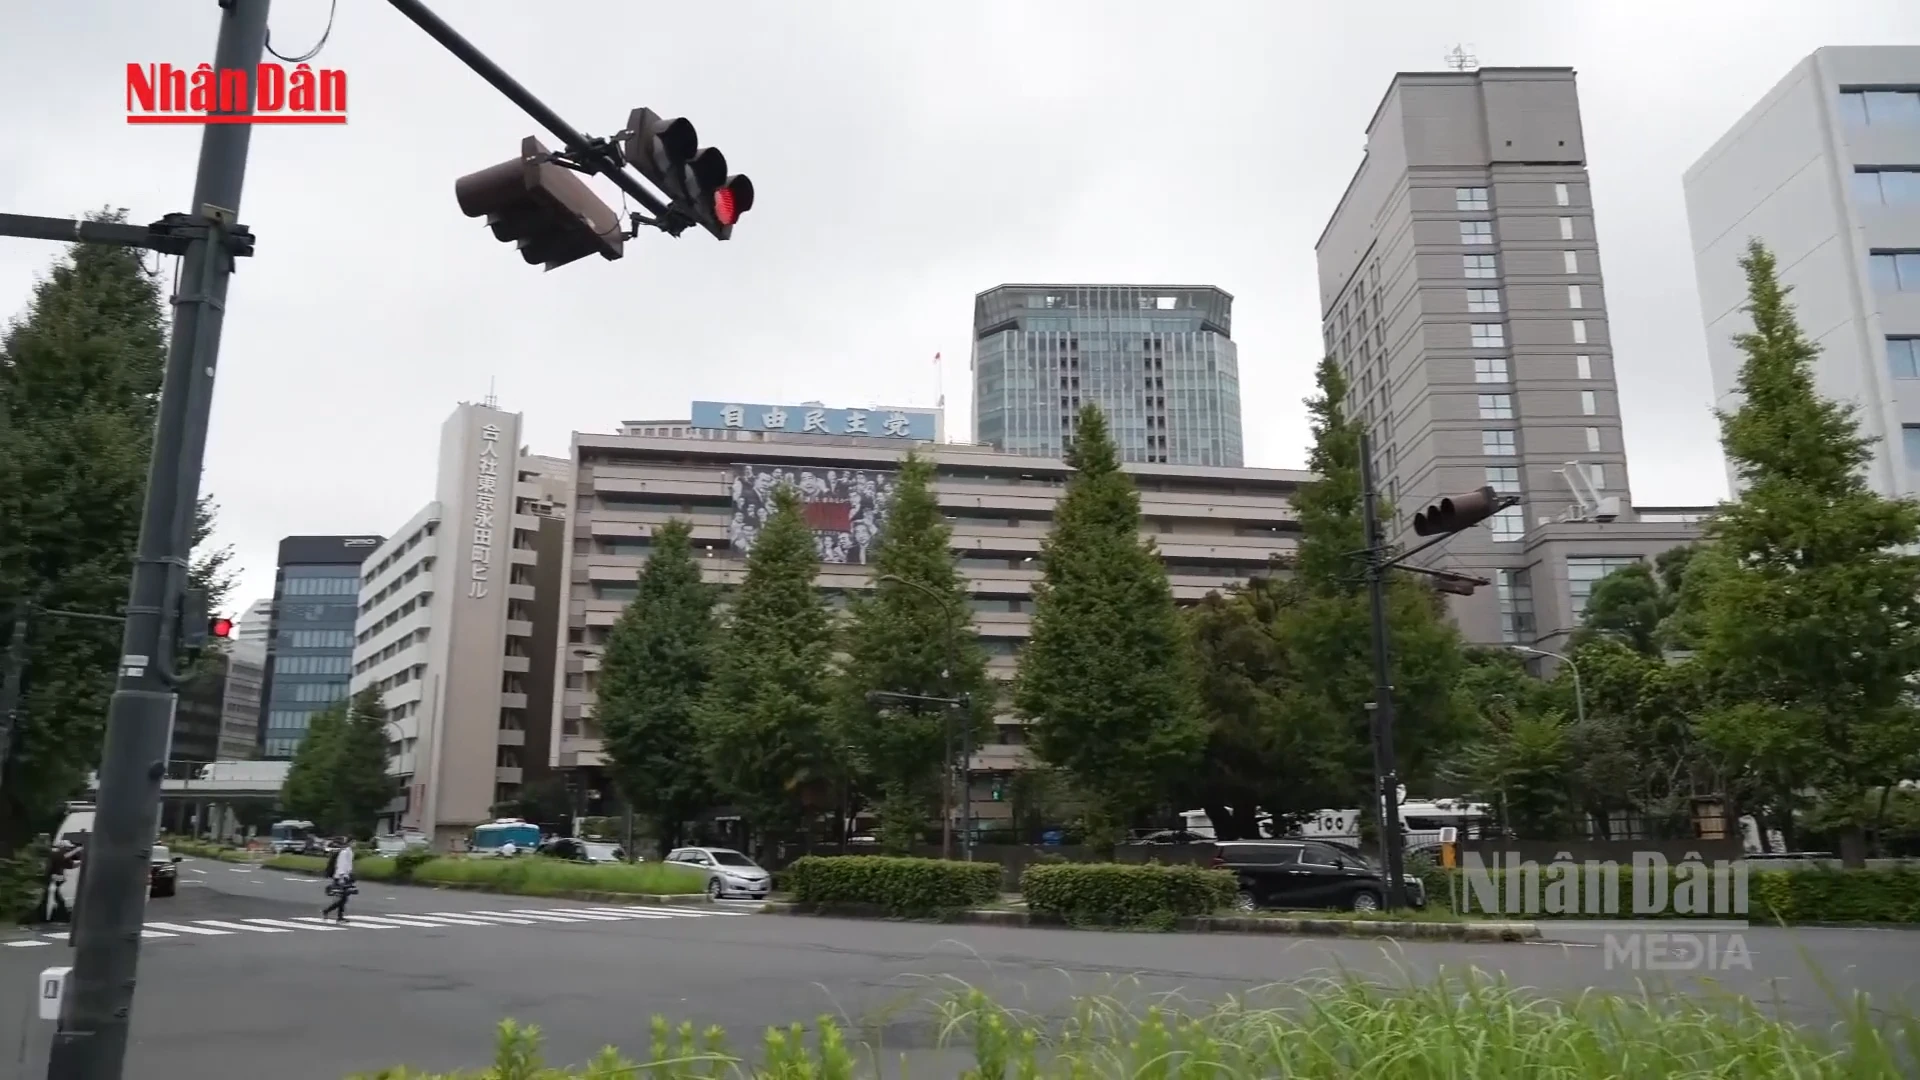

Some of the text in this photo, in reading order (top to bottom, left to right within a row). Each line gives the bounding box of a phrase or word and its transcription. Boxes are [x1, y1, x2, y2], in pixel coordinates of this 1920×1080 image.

[719, 404, 910, 437] 自由民主党
[467, 422, 500, 600] 合人社東京永田町ビル
